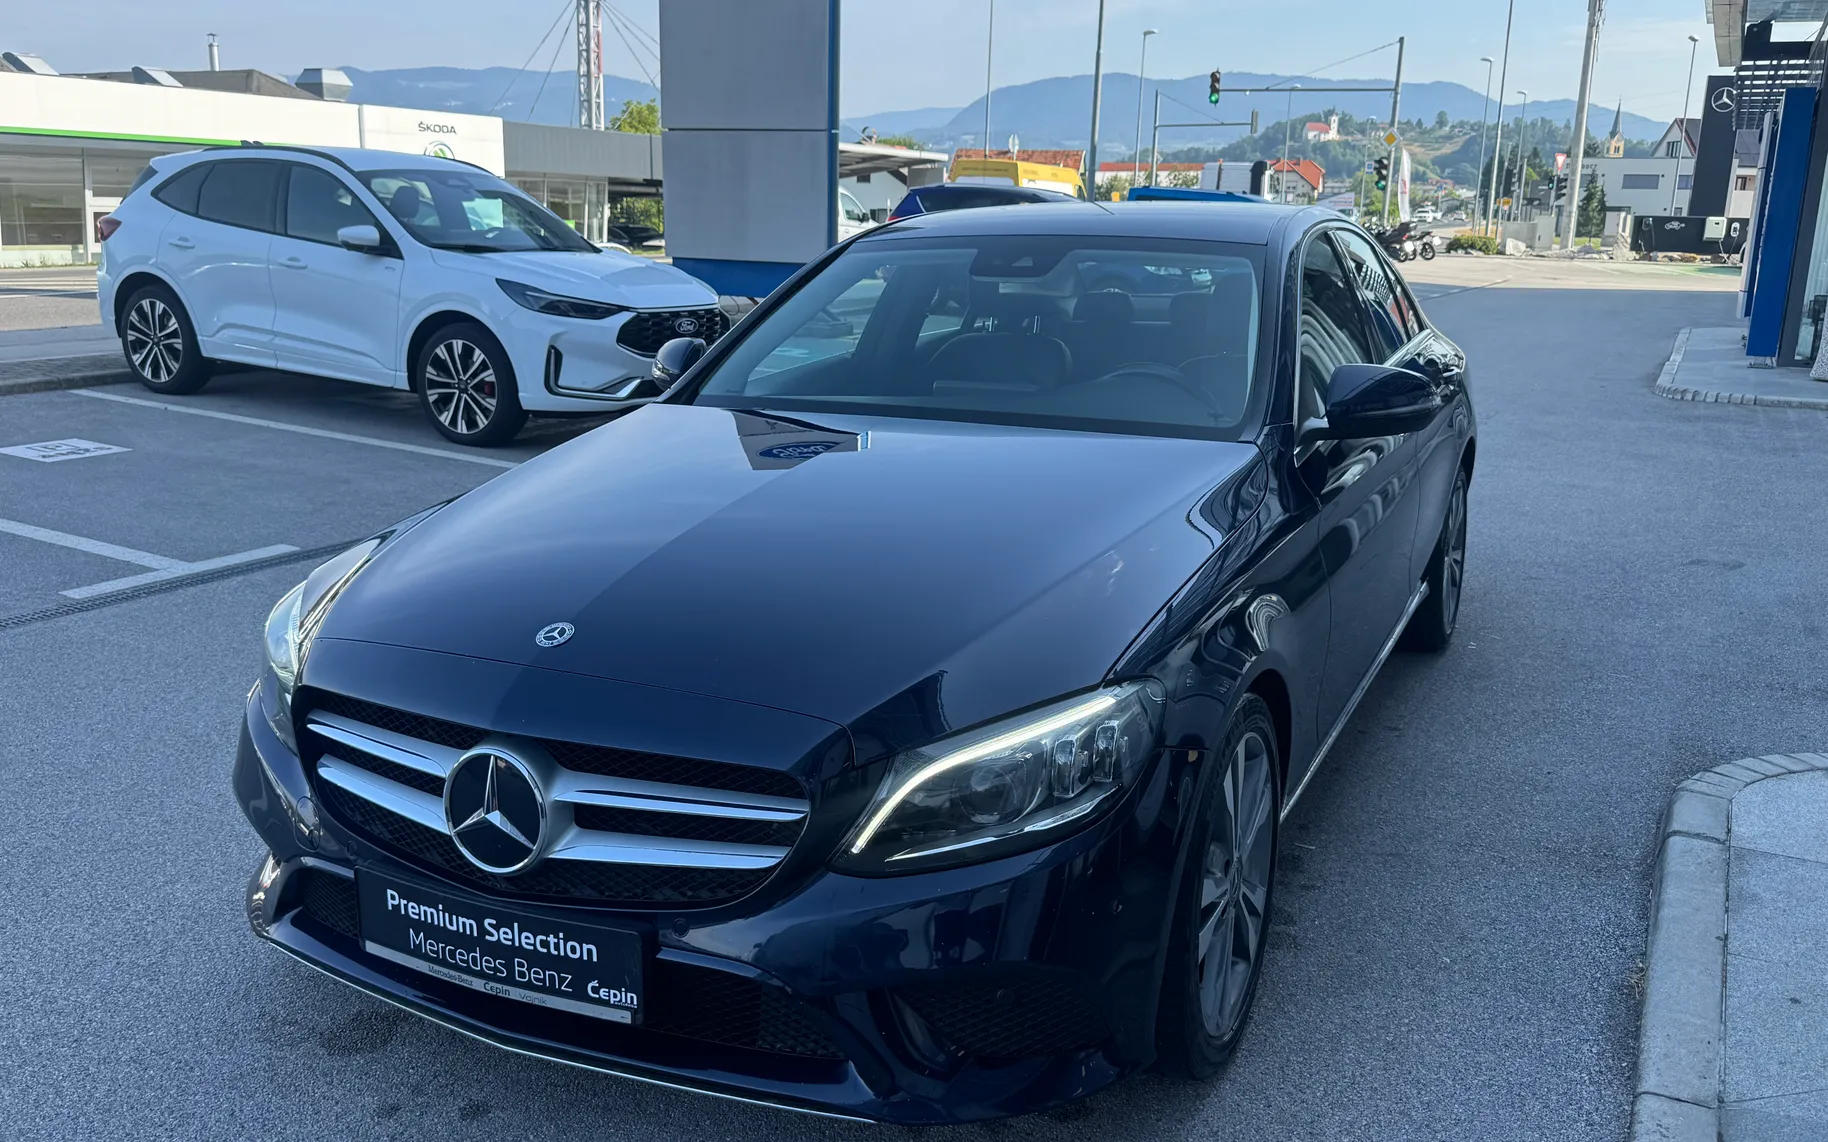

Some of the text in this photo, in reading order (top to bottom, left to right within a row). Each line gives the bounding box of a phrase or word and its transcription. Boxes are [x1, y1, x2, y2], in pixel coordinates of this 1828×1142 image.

[418, 121, 457, 135] ŠKODA
[386, 888, 598, 962] Premium Selection
[409, 927, 573, 992] Mercedes Benz
[587, 980, 638, 1005] Čepin
